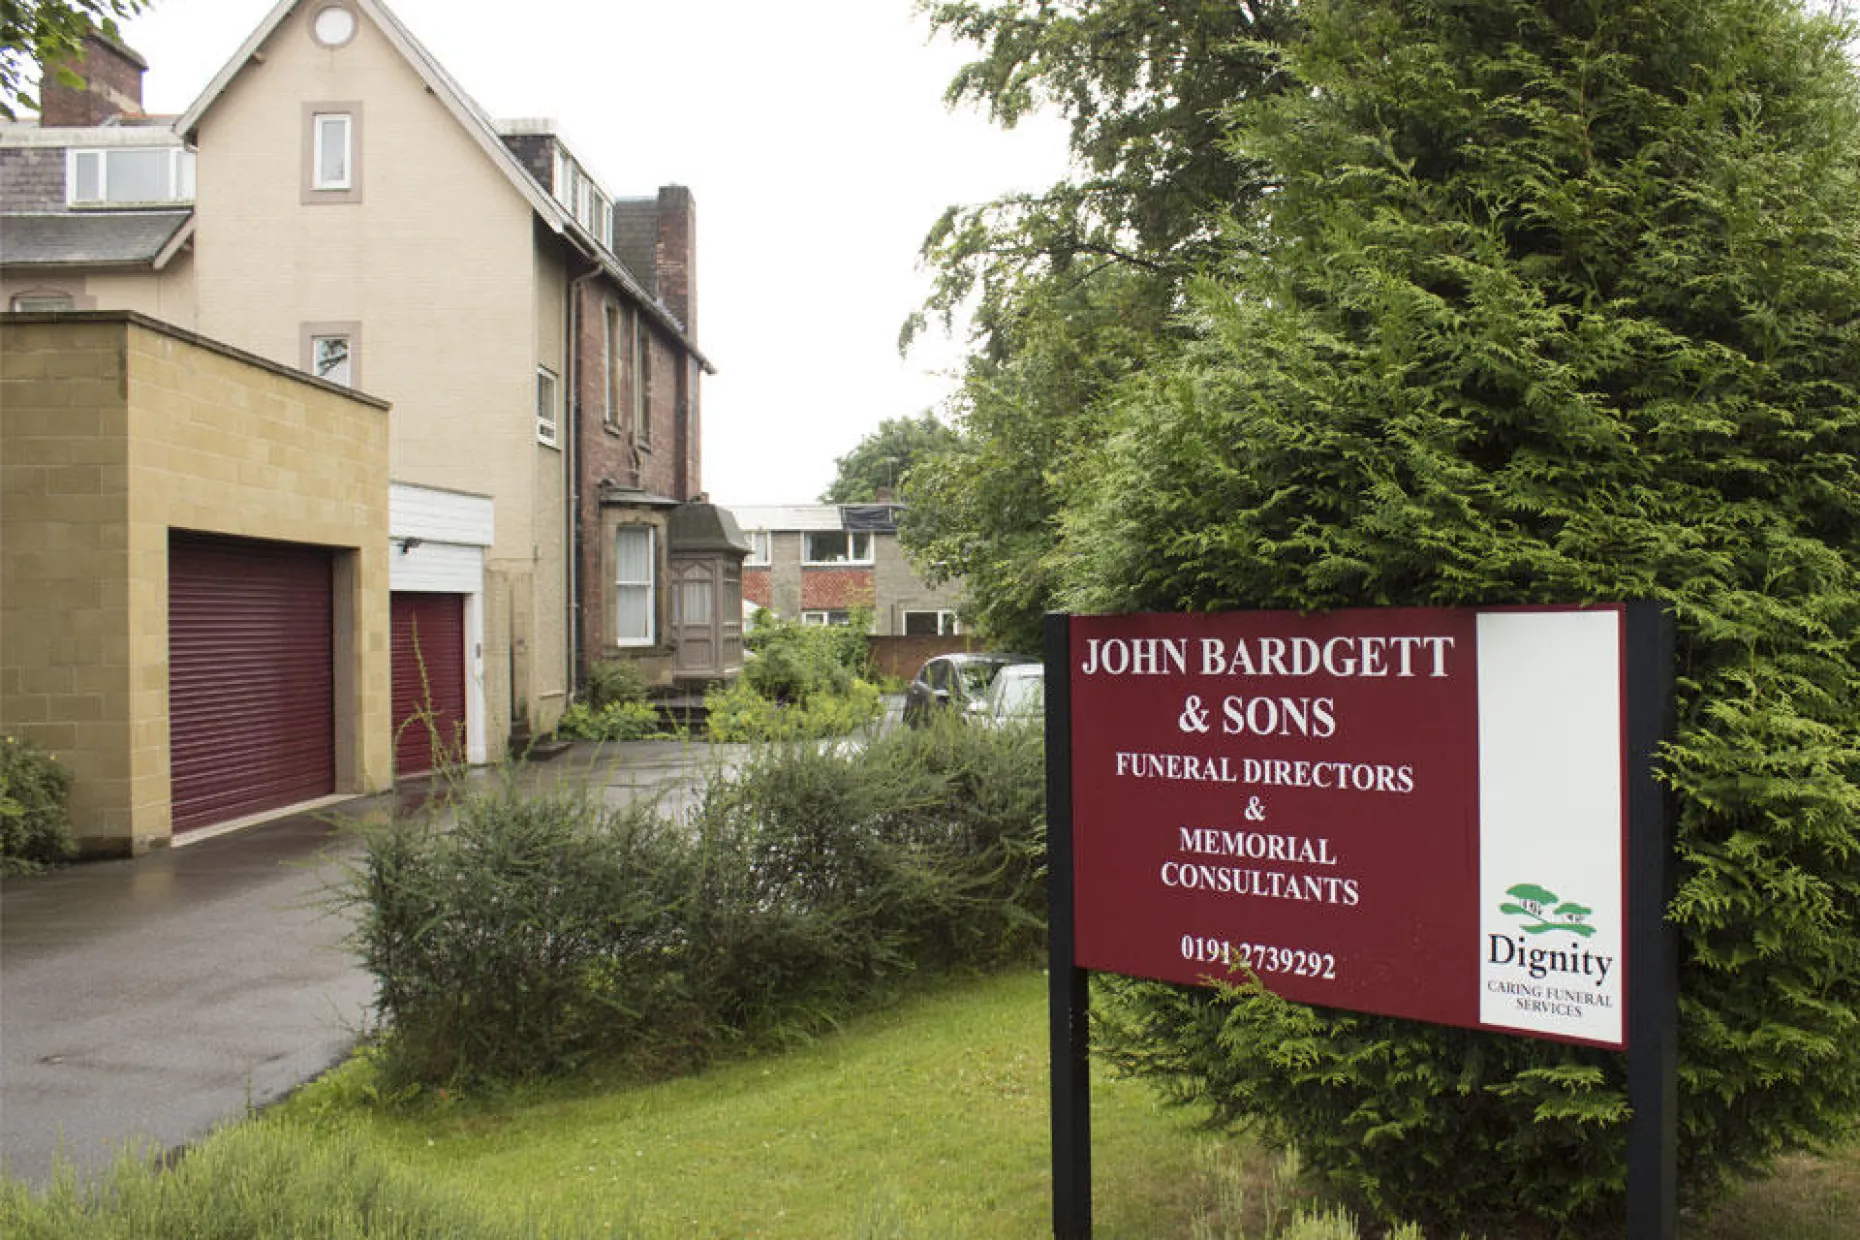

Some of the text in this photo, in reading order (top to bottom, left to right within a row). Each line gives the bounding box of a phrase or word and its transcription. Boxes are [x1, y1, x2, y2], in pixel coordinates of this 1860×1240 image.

[1082, 637, 1455, 677] JOHN BARDGETT
[1178, 695, 1336, 737] & SONS
[1116, 753, 1414, 793] FUNERAL DIRECTORS
[1244, 796, 1266, 822] &
[1179, 827, 1337, 865] MEMORIAL
[1161, 861, 1359, 905] CONSULTANTS
[1181, 935, 1336, 980] 0191 2739292
[1488, 933, 1613, 986] Dignity
[1487, 980, 1613, 1008] CARING FUNERAL
[1516, 998, 1582, 1017] SERVICES
